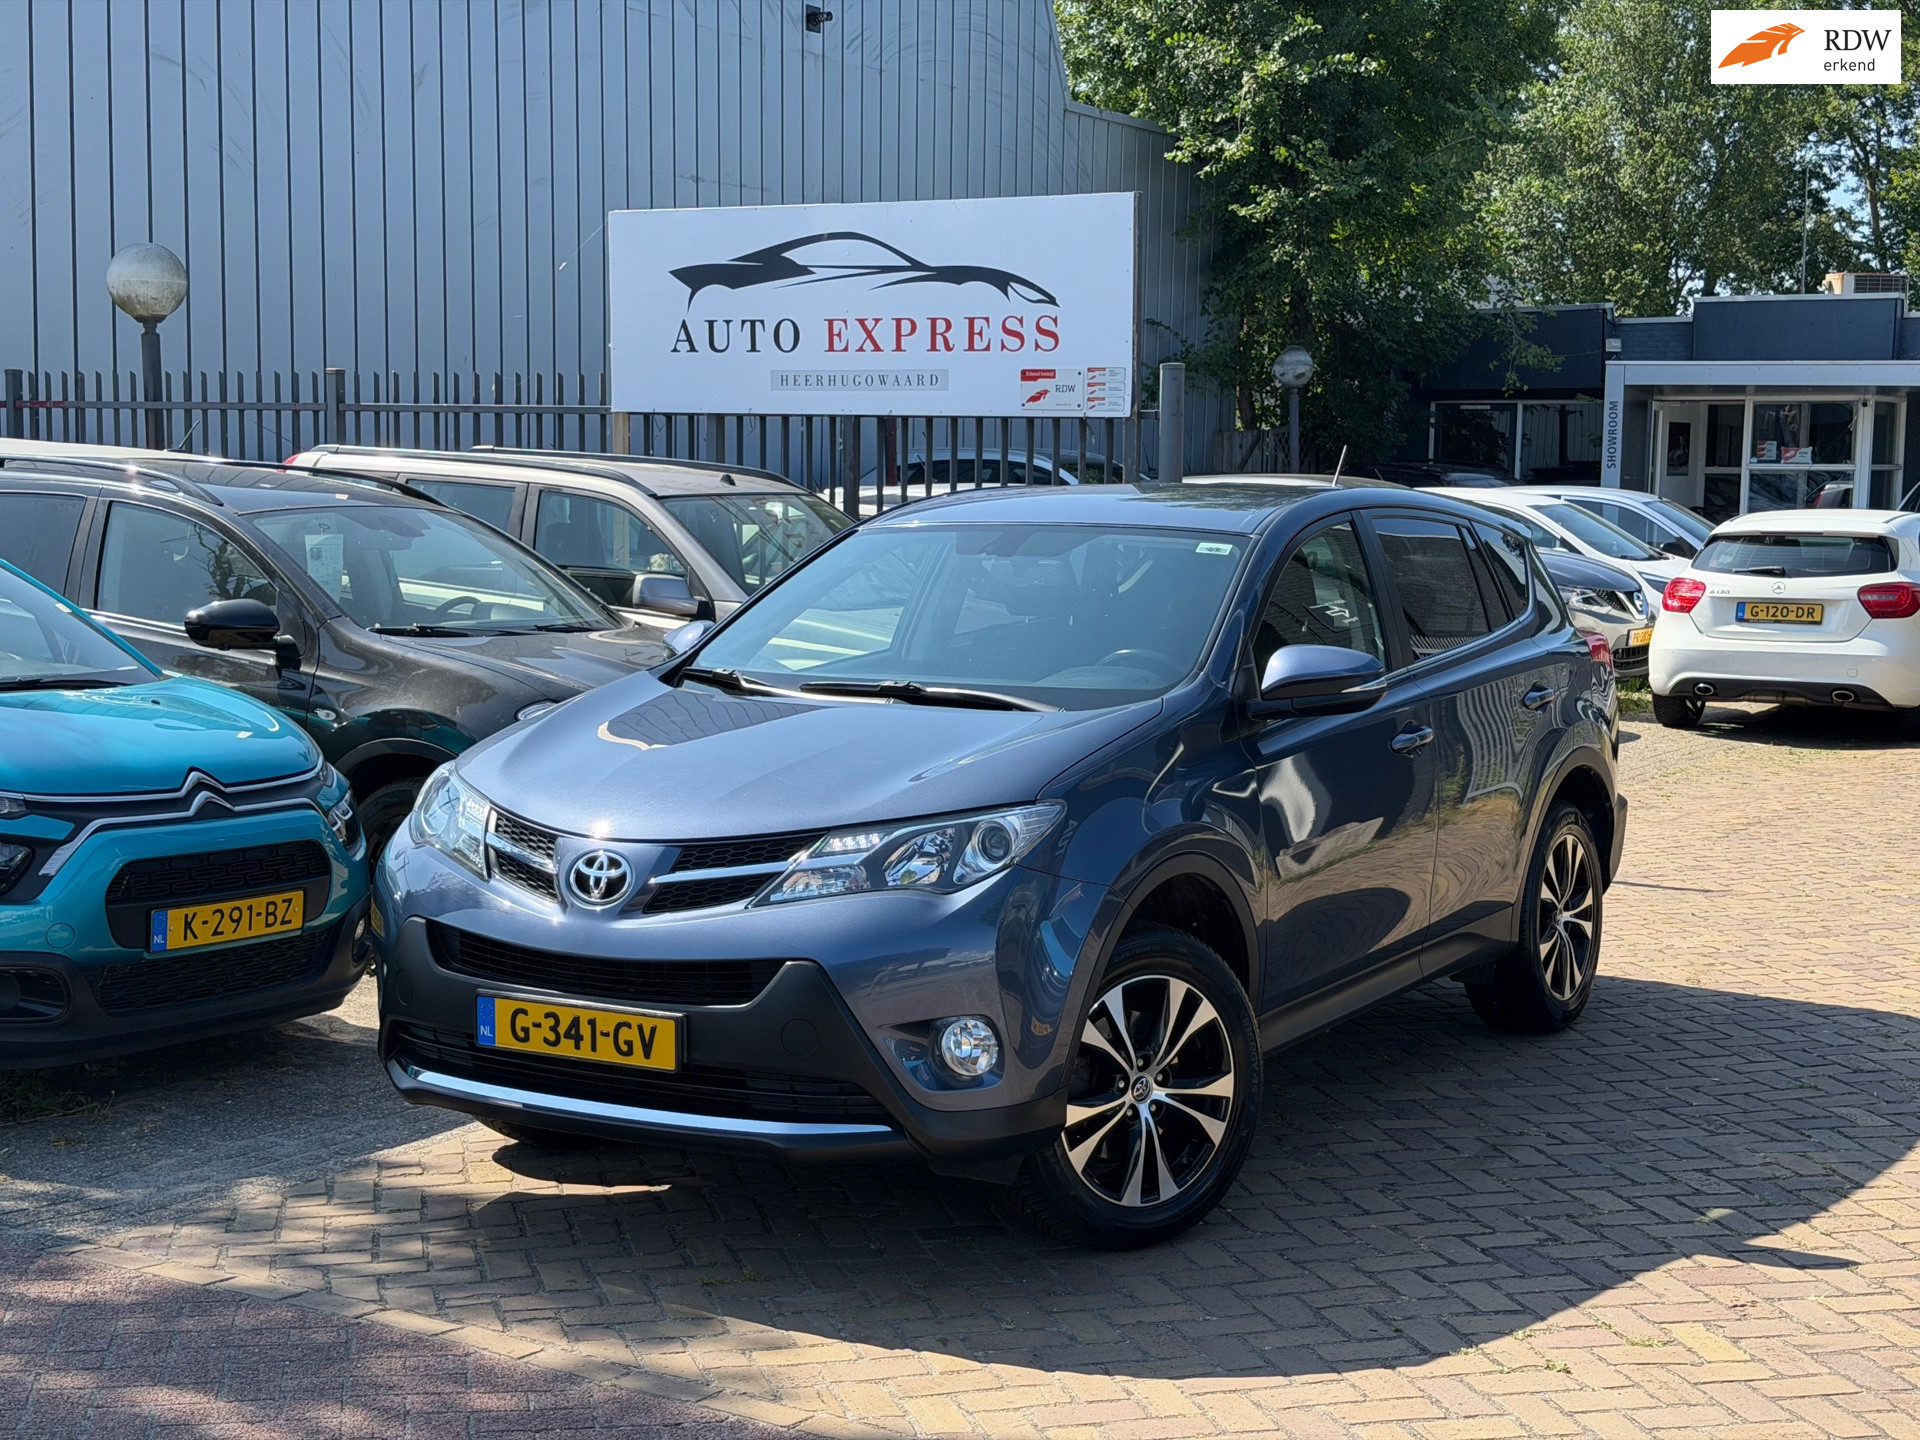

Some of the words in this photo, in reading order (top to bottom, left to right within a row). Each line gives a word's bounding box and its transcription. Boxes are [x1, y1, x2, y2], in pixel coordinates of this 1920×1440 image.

[670, 318, 801, 353] AUTO
[823, 315, 1060, 352] EXPRESS
[780, 373, 940, 388] HEERHUGOWAARD
[1055, 384, 1076, 393] RDW
[1607, 401, 1618, 469] SHOWROOM
[1750, 604, 1816, 620] G-120-DR
[153, 934, 165, 944] NL
[183, 898, 293, 941] K-291-BZ
[480, 1026, 493, 1037] NL
[510, 1007, 657, 1060] G-341-GV
